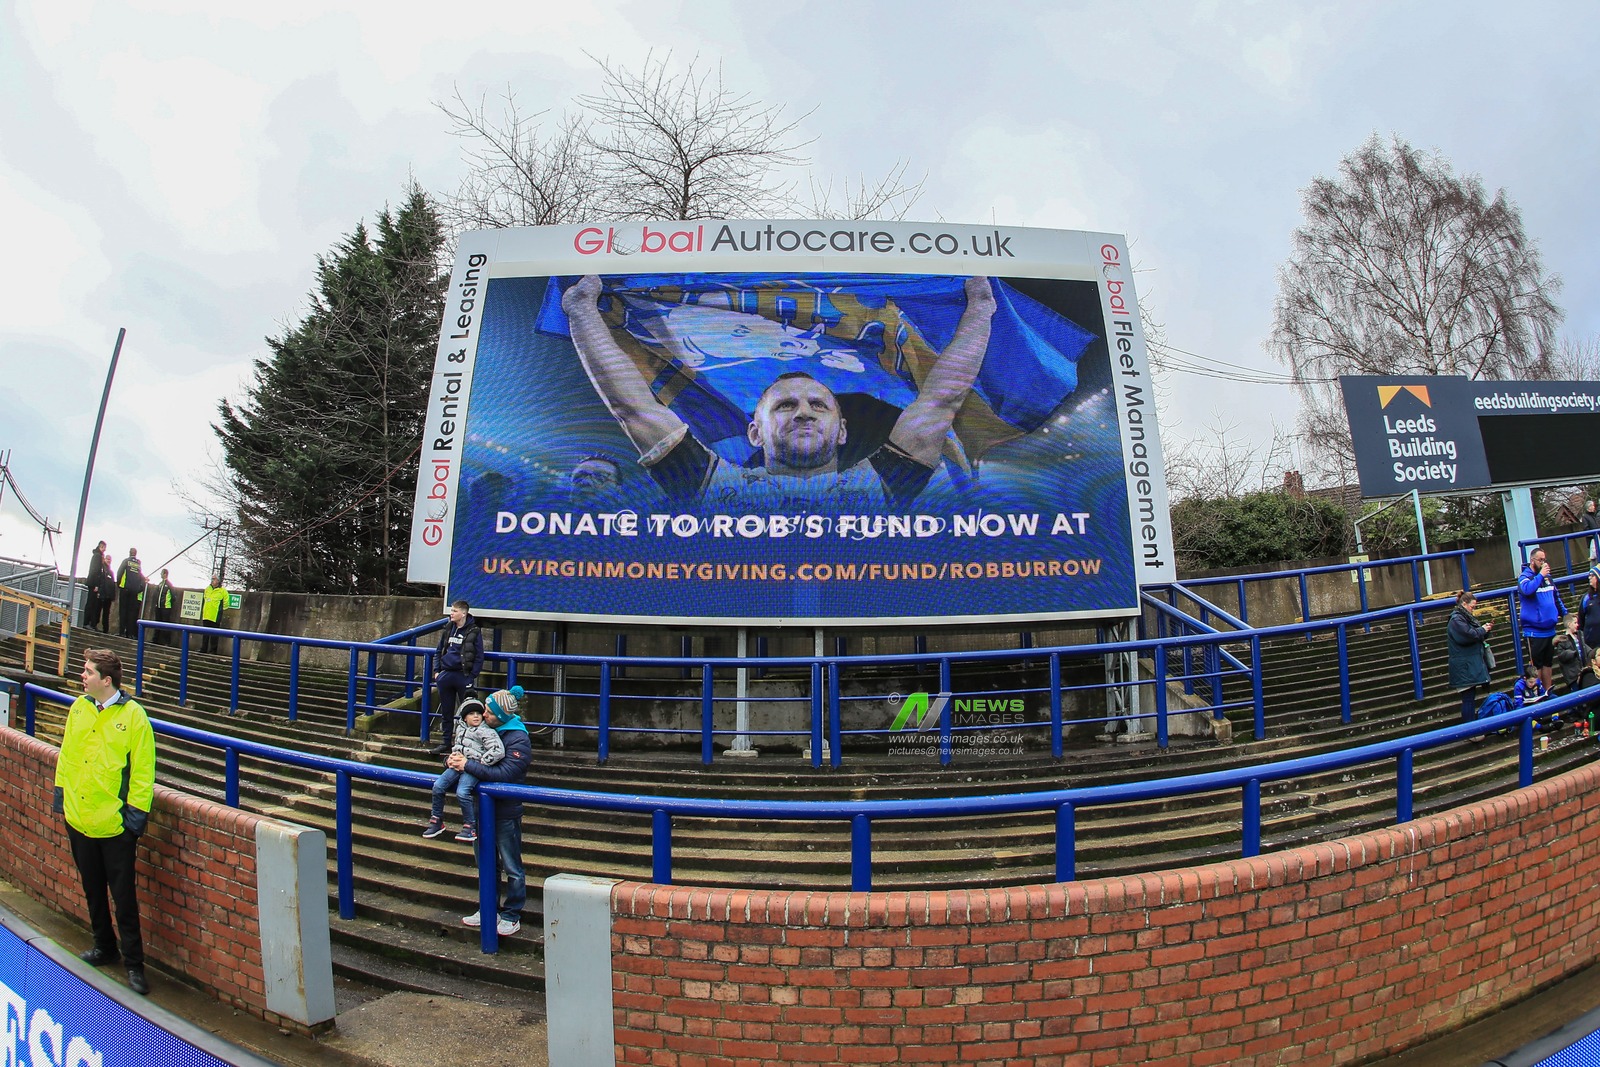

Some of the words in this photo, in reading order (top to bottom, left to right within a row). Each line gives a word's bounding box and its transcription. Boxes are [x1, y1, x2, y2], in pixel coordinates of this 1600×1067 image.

[574, 225, 703, 255] Global
[711, 225, 1015, 258] Autocare.co.uk
[450, 253, 487, 340] Leasing
[448, 348, 466, 364] &
[1113, 321, 1141, 378] Fleet
[433, 372, 463, 451] Rental
[1383, 414, 1436, 434] Leeds
[1388, 436, 1457, 460] Building
[1123, 384, 1164, 569] Management
[1393, 460, 1457, 484] Society
[495, 511, 638, 537] DONATE
[651, 514, 699, 537] TO
[713, 514, 824, 538] ROB'S
[839, 514, 938, 538] FUND
[953, 513, 1039, 537] NOW
[1050, 512, 1090, 536] AT
[483, 557, 1101, 580] UK.VIRGINMONEYGIVING.COM/FUND/ROBBURROW
